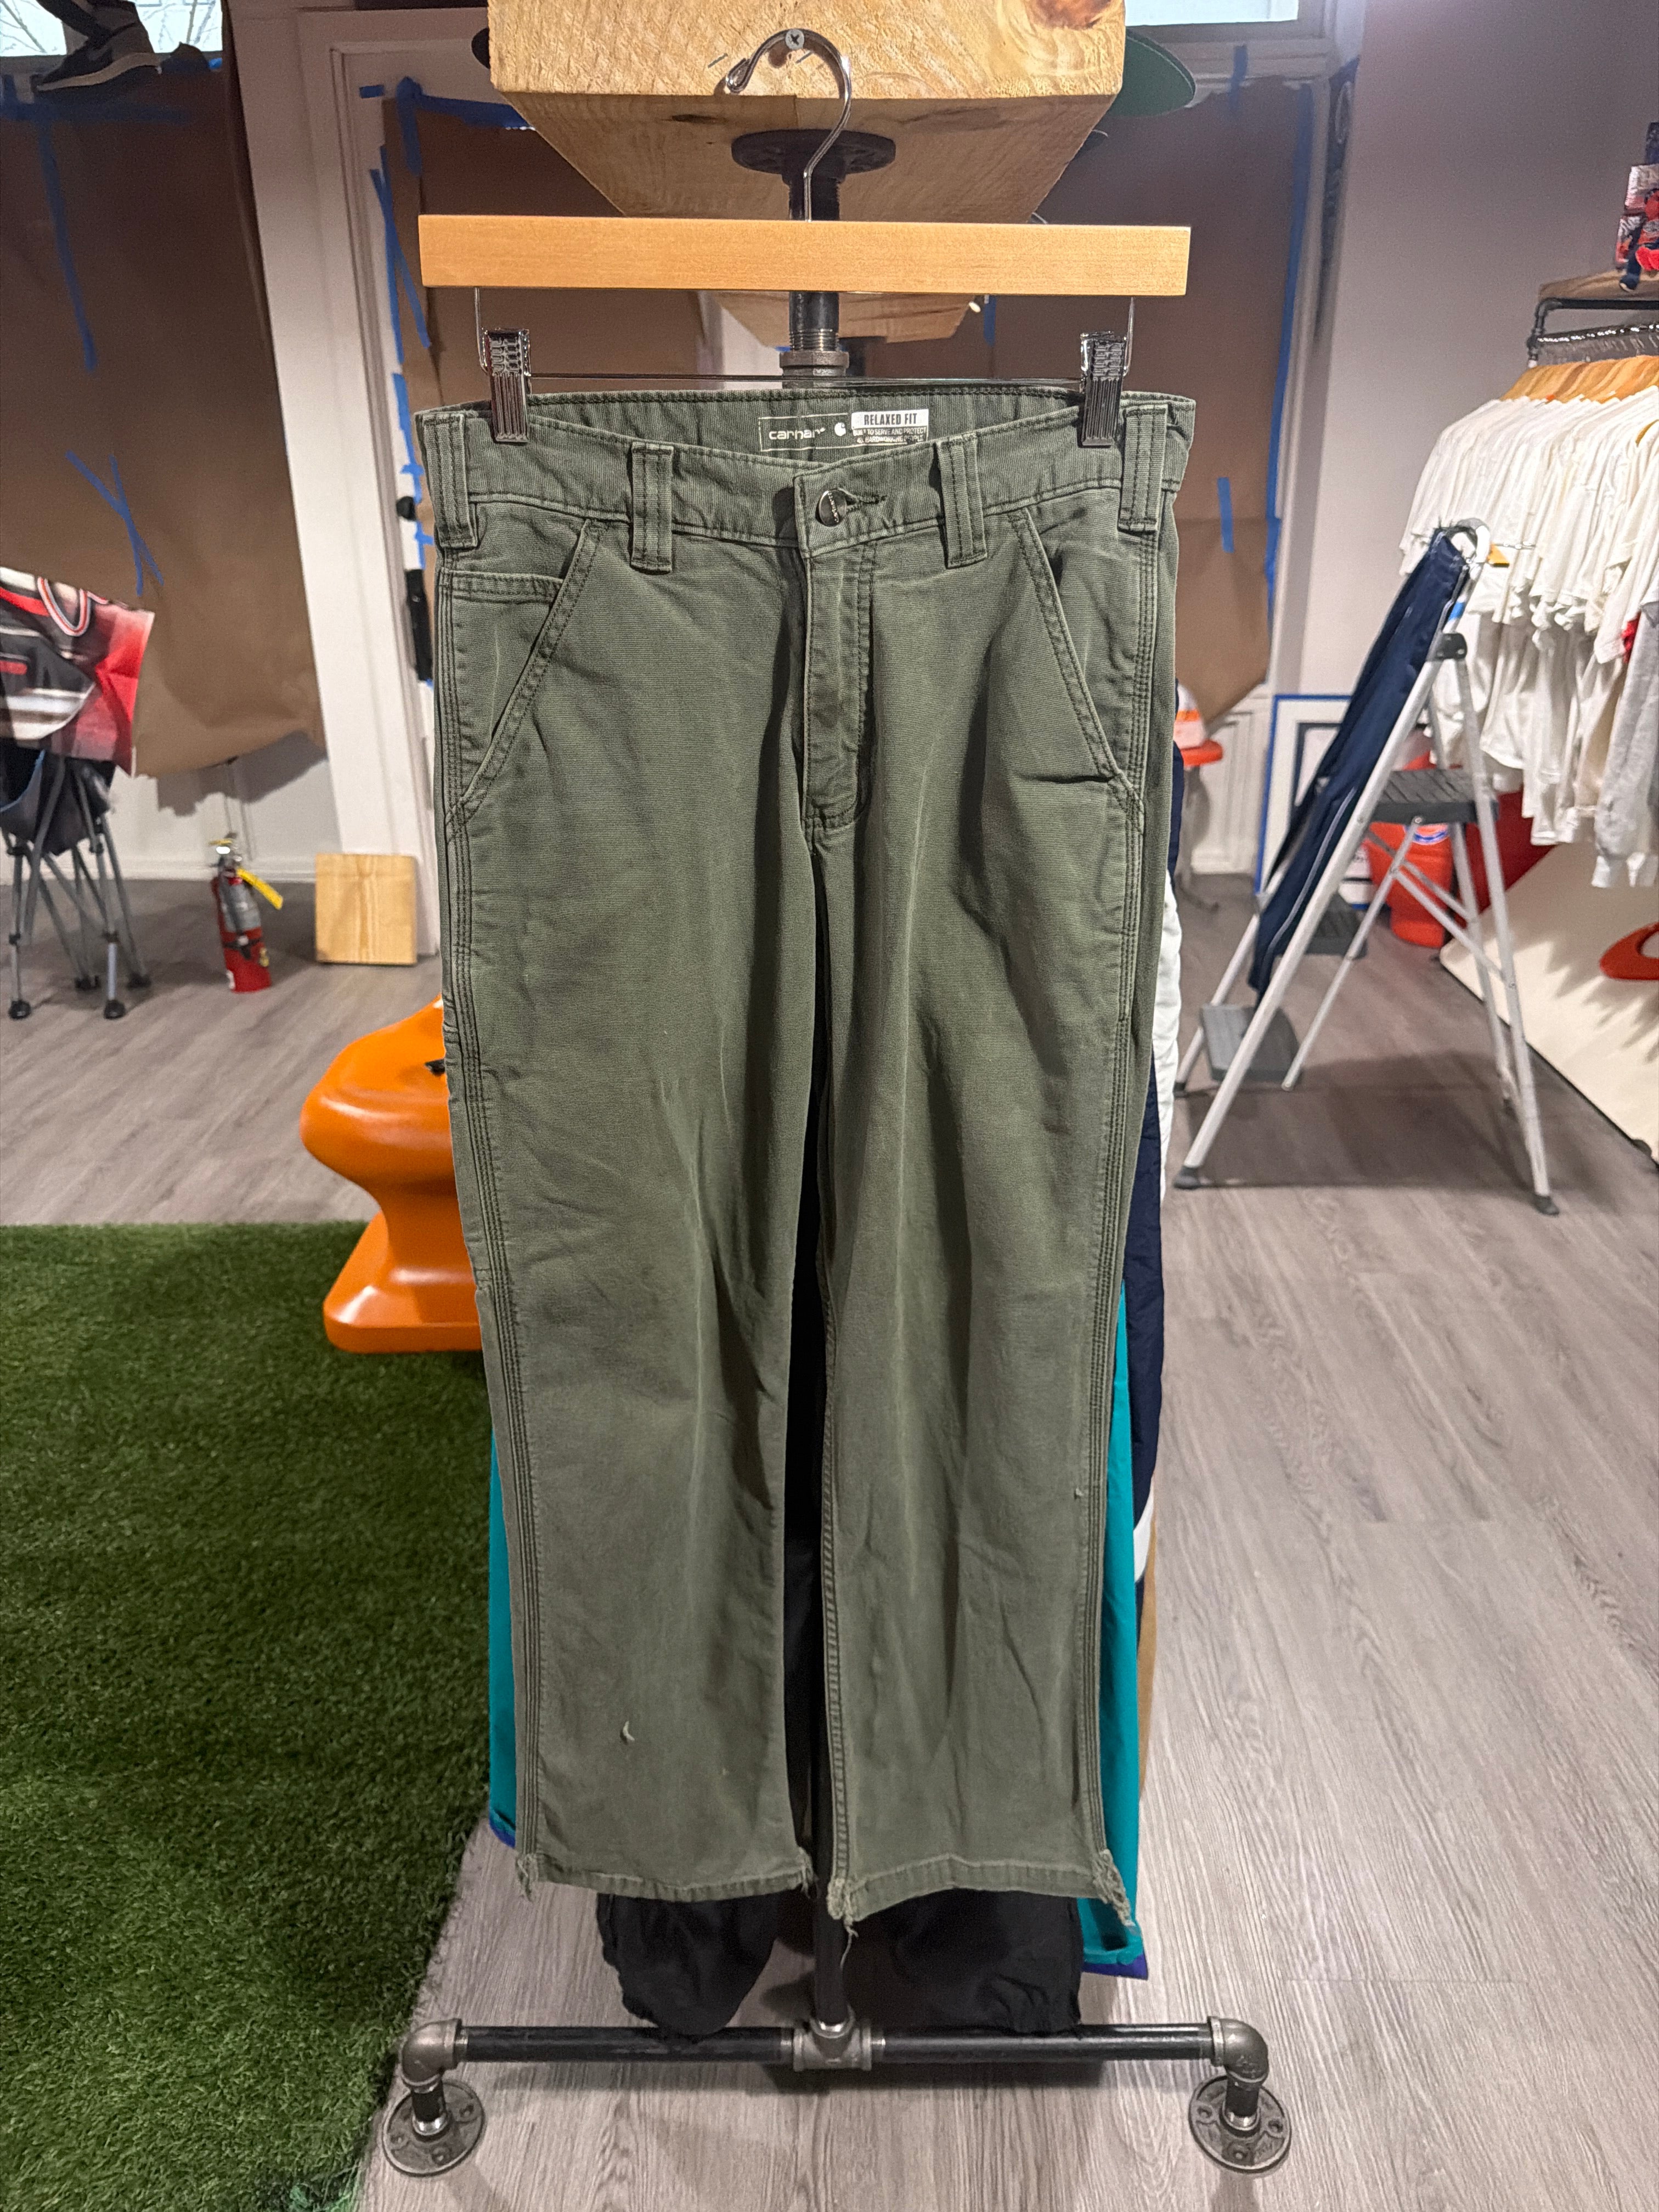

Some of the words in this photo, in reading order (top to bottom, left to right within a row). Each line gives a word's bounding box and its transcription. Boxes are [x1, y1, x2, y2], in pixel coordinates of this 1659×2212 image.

[864, 413, 901, 426] RELAXED
[904, 413, 917, 425] FIT
[903, 427, 927, 435] PROTECT
